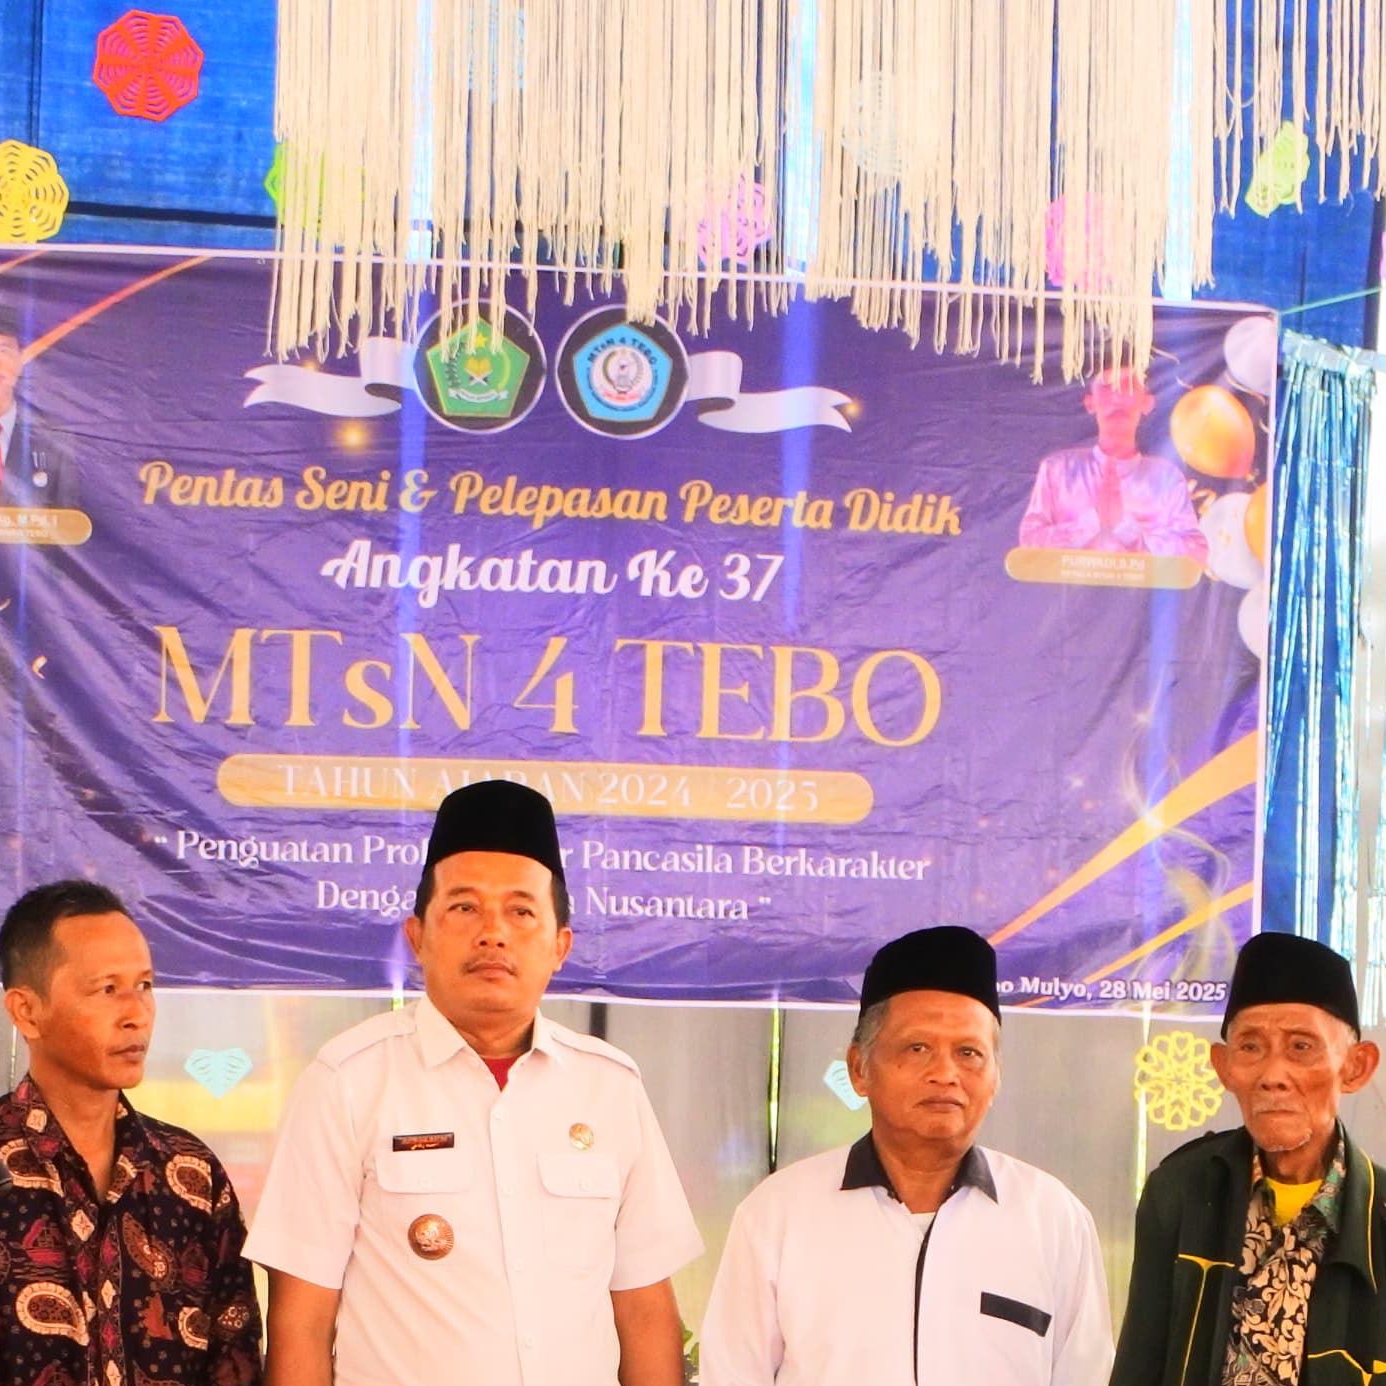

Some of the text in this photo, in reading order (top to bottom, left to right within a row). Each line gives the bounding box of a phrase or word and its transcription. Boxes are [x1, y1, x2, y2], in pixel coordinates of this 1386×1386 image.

[139, 461, 963, 536] Pentas Seni & Pelepasan Peserta Didik
[320, 539, 785, 609] Angkatan Ke 37
[153, 624, 944, 748] MTsN 4 TEBO
[277, 765, 819, 812] TAHUN AAN 2024 2025
[177, 829, 353, 868] Penguatan
[582, 840, 733, 874] Pancasila
[743, 846, 930, 881] Berkarakter
[317, 880, 417, 919] Denga
[586, 886, 749, 920] Nusantara
[1020, 976, 1092, 1000] Mulyo,
[1100, 980, 1126, 999] 28
[1133, 981, 1170, 1000] Mei
[1177, 983, 1227, 1001] 2025
